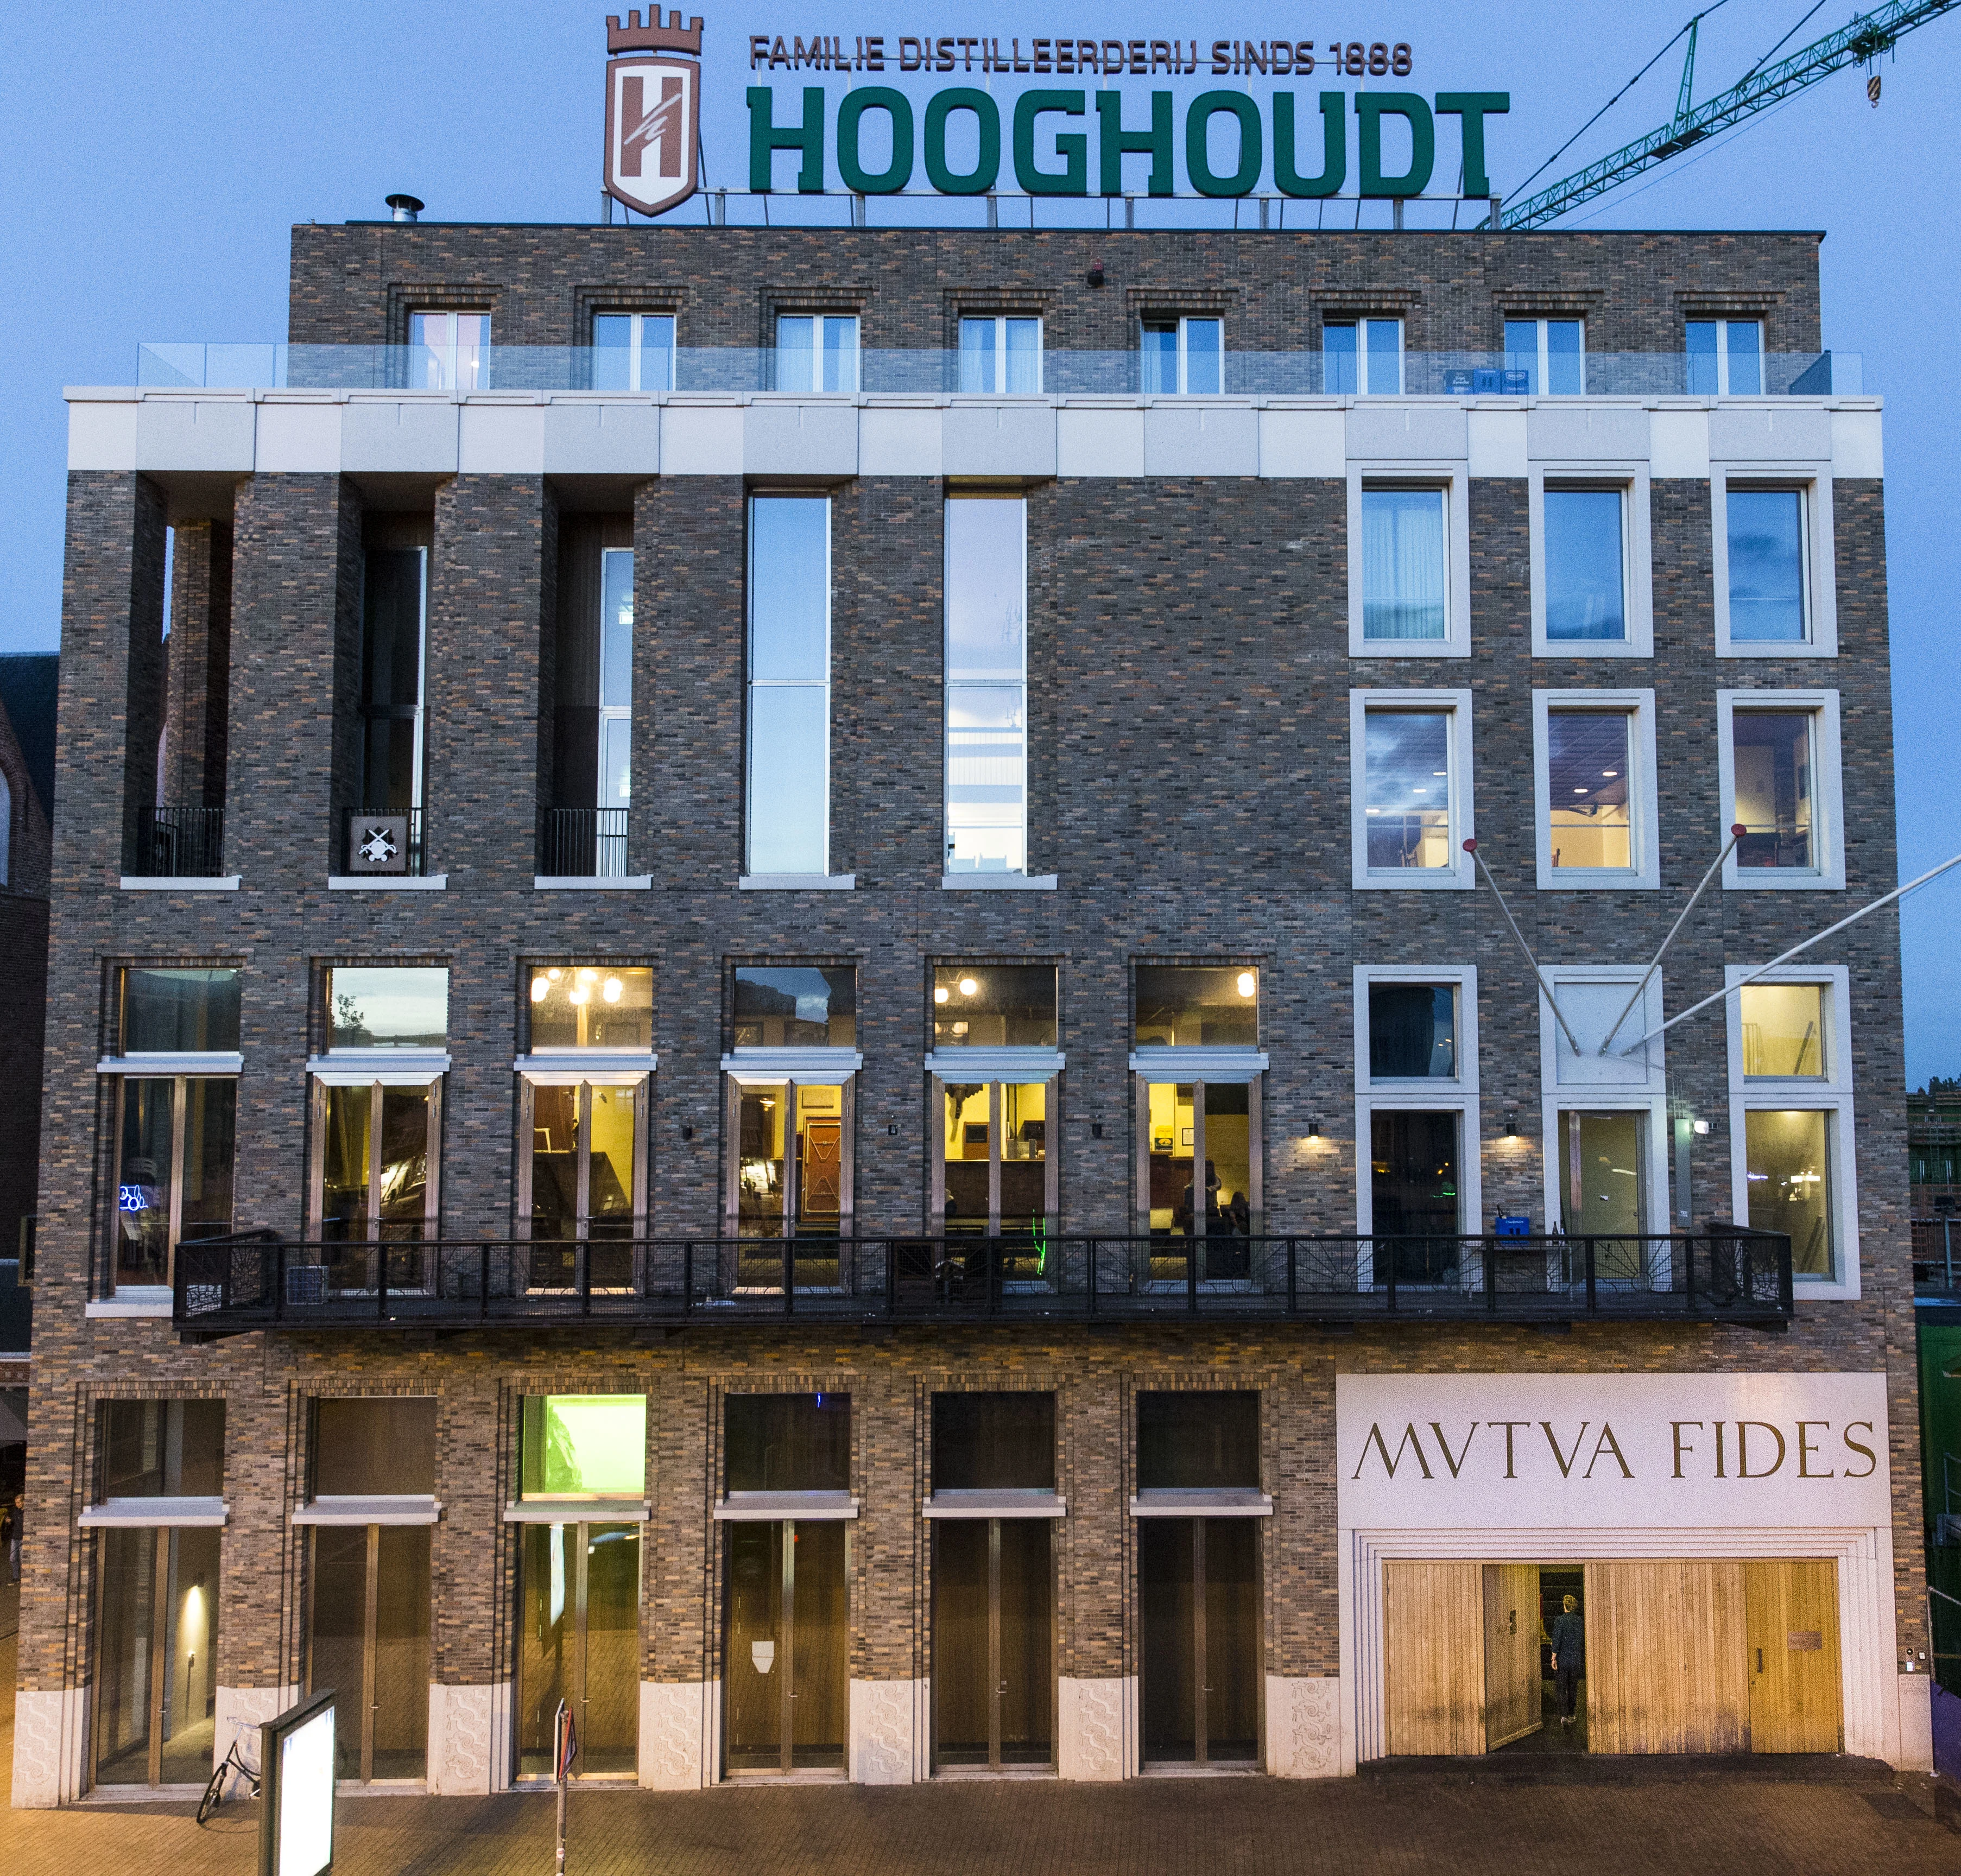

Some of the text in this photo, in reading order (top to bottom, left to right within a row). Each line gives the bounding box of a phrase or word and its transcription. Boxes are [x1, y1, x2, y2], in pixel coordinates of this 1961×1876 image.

[750, 35, 1412, 77] FAMILIE DISTILLEERDERIJ SINDS 1888
[747, 86, 1510, 198] HOOGHOUDT
[1351, 1420, 1876, 1480] MVTVA FIDES
